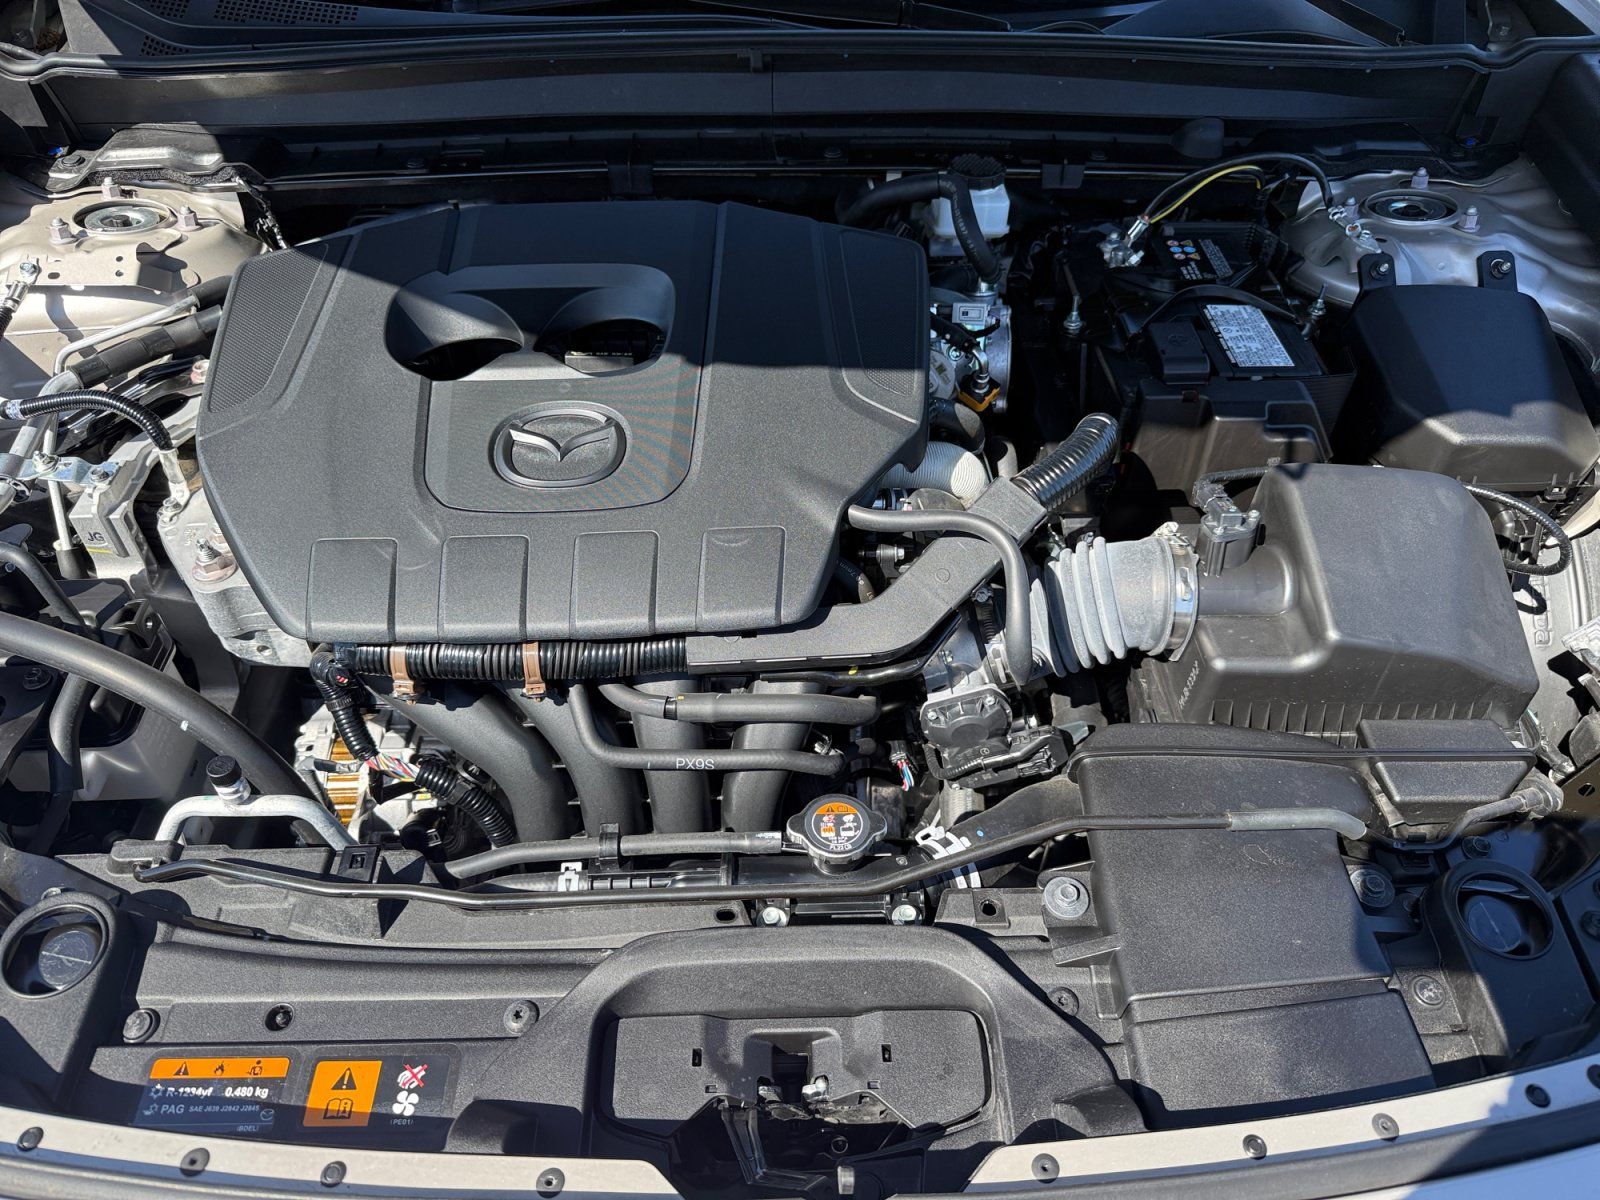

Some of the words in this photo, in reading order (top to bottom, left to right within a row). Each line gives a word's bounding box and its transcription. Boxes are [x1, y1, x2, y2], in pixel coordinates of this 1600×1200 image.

[676, 757, 715, 770] PX9S
[165, 1087, 214, 1099] R-1234yf
[224, 1086, 254, 1098] 0.480
[254, 1086, 269, 1099] kg
[160, 1104, 185, 1115] PAG
